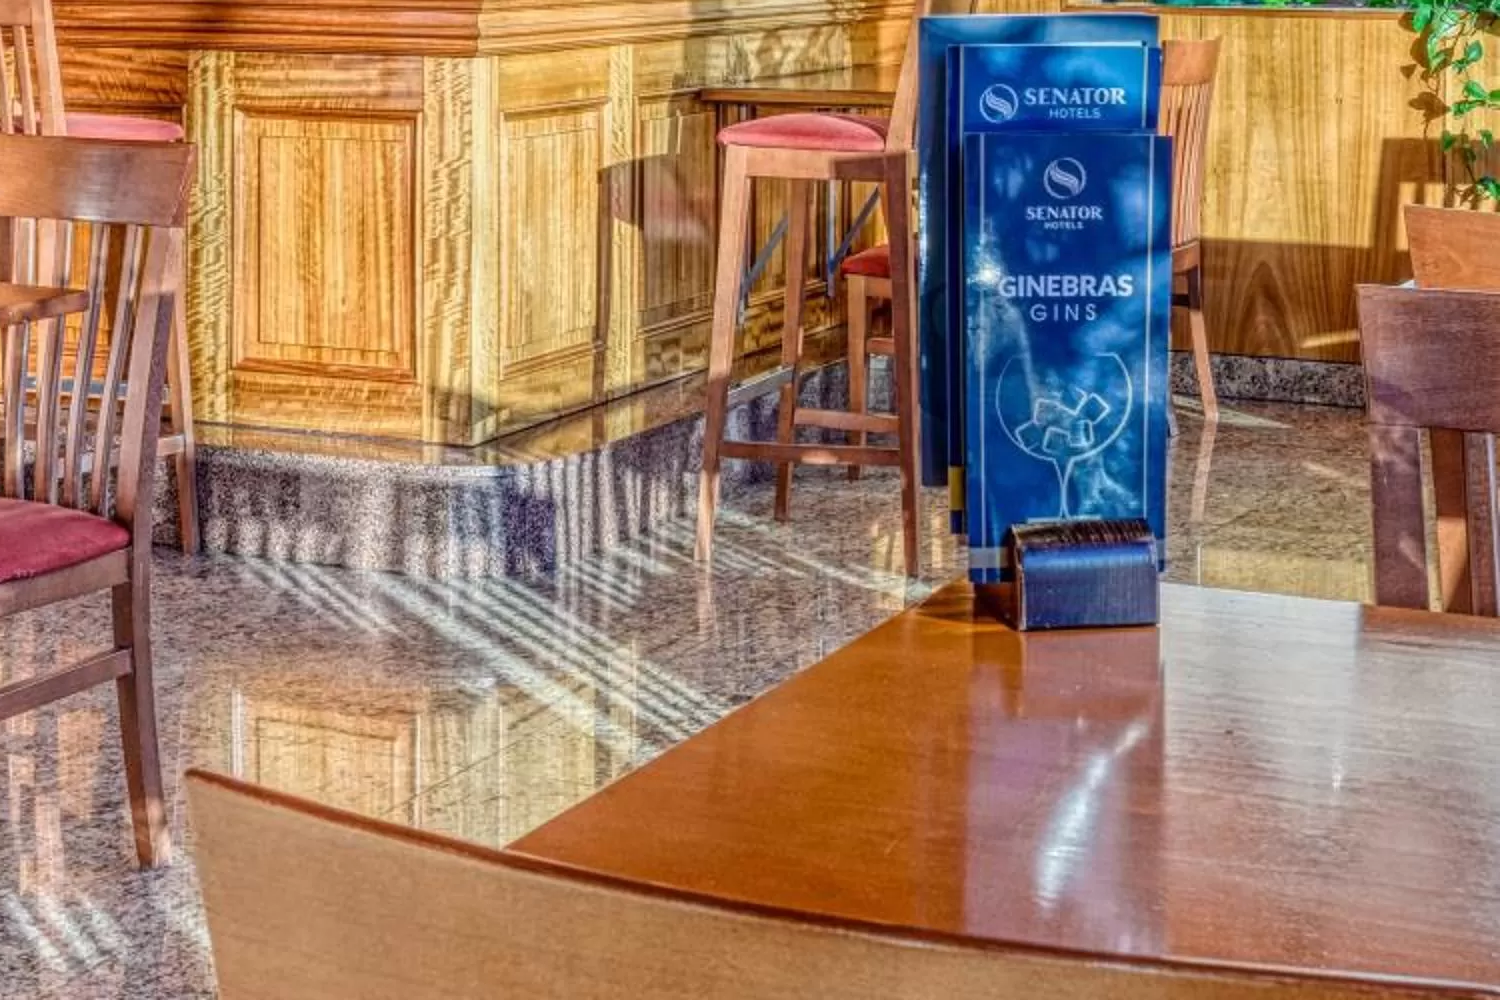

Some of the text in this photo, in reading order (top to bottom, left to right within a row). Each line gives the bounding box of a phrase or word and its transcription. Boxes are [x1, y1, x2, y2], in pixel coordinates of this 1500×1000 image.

[1024, 87, 1127, 105] SENATOR
[1049, 107, 1101, 119] HOTELS
[1025, 205, 1103, 220] SENATOR
[1044, 221, 1084, 230] HOTELS
[999, 273, 1134, 298] GINEBRAS
[1029, 303, 1097, 322] GINS
